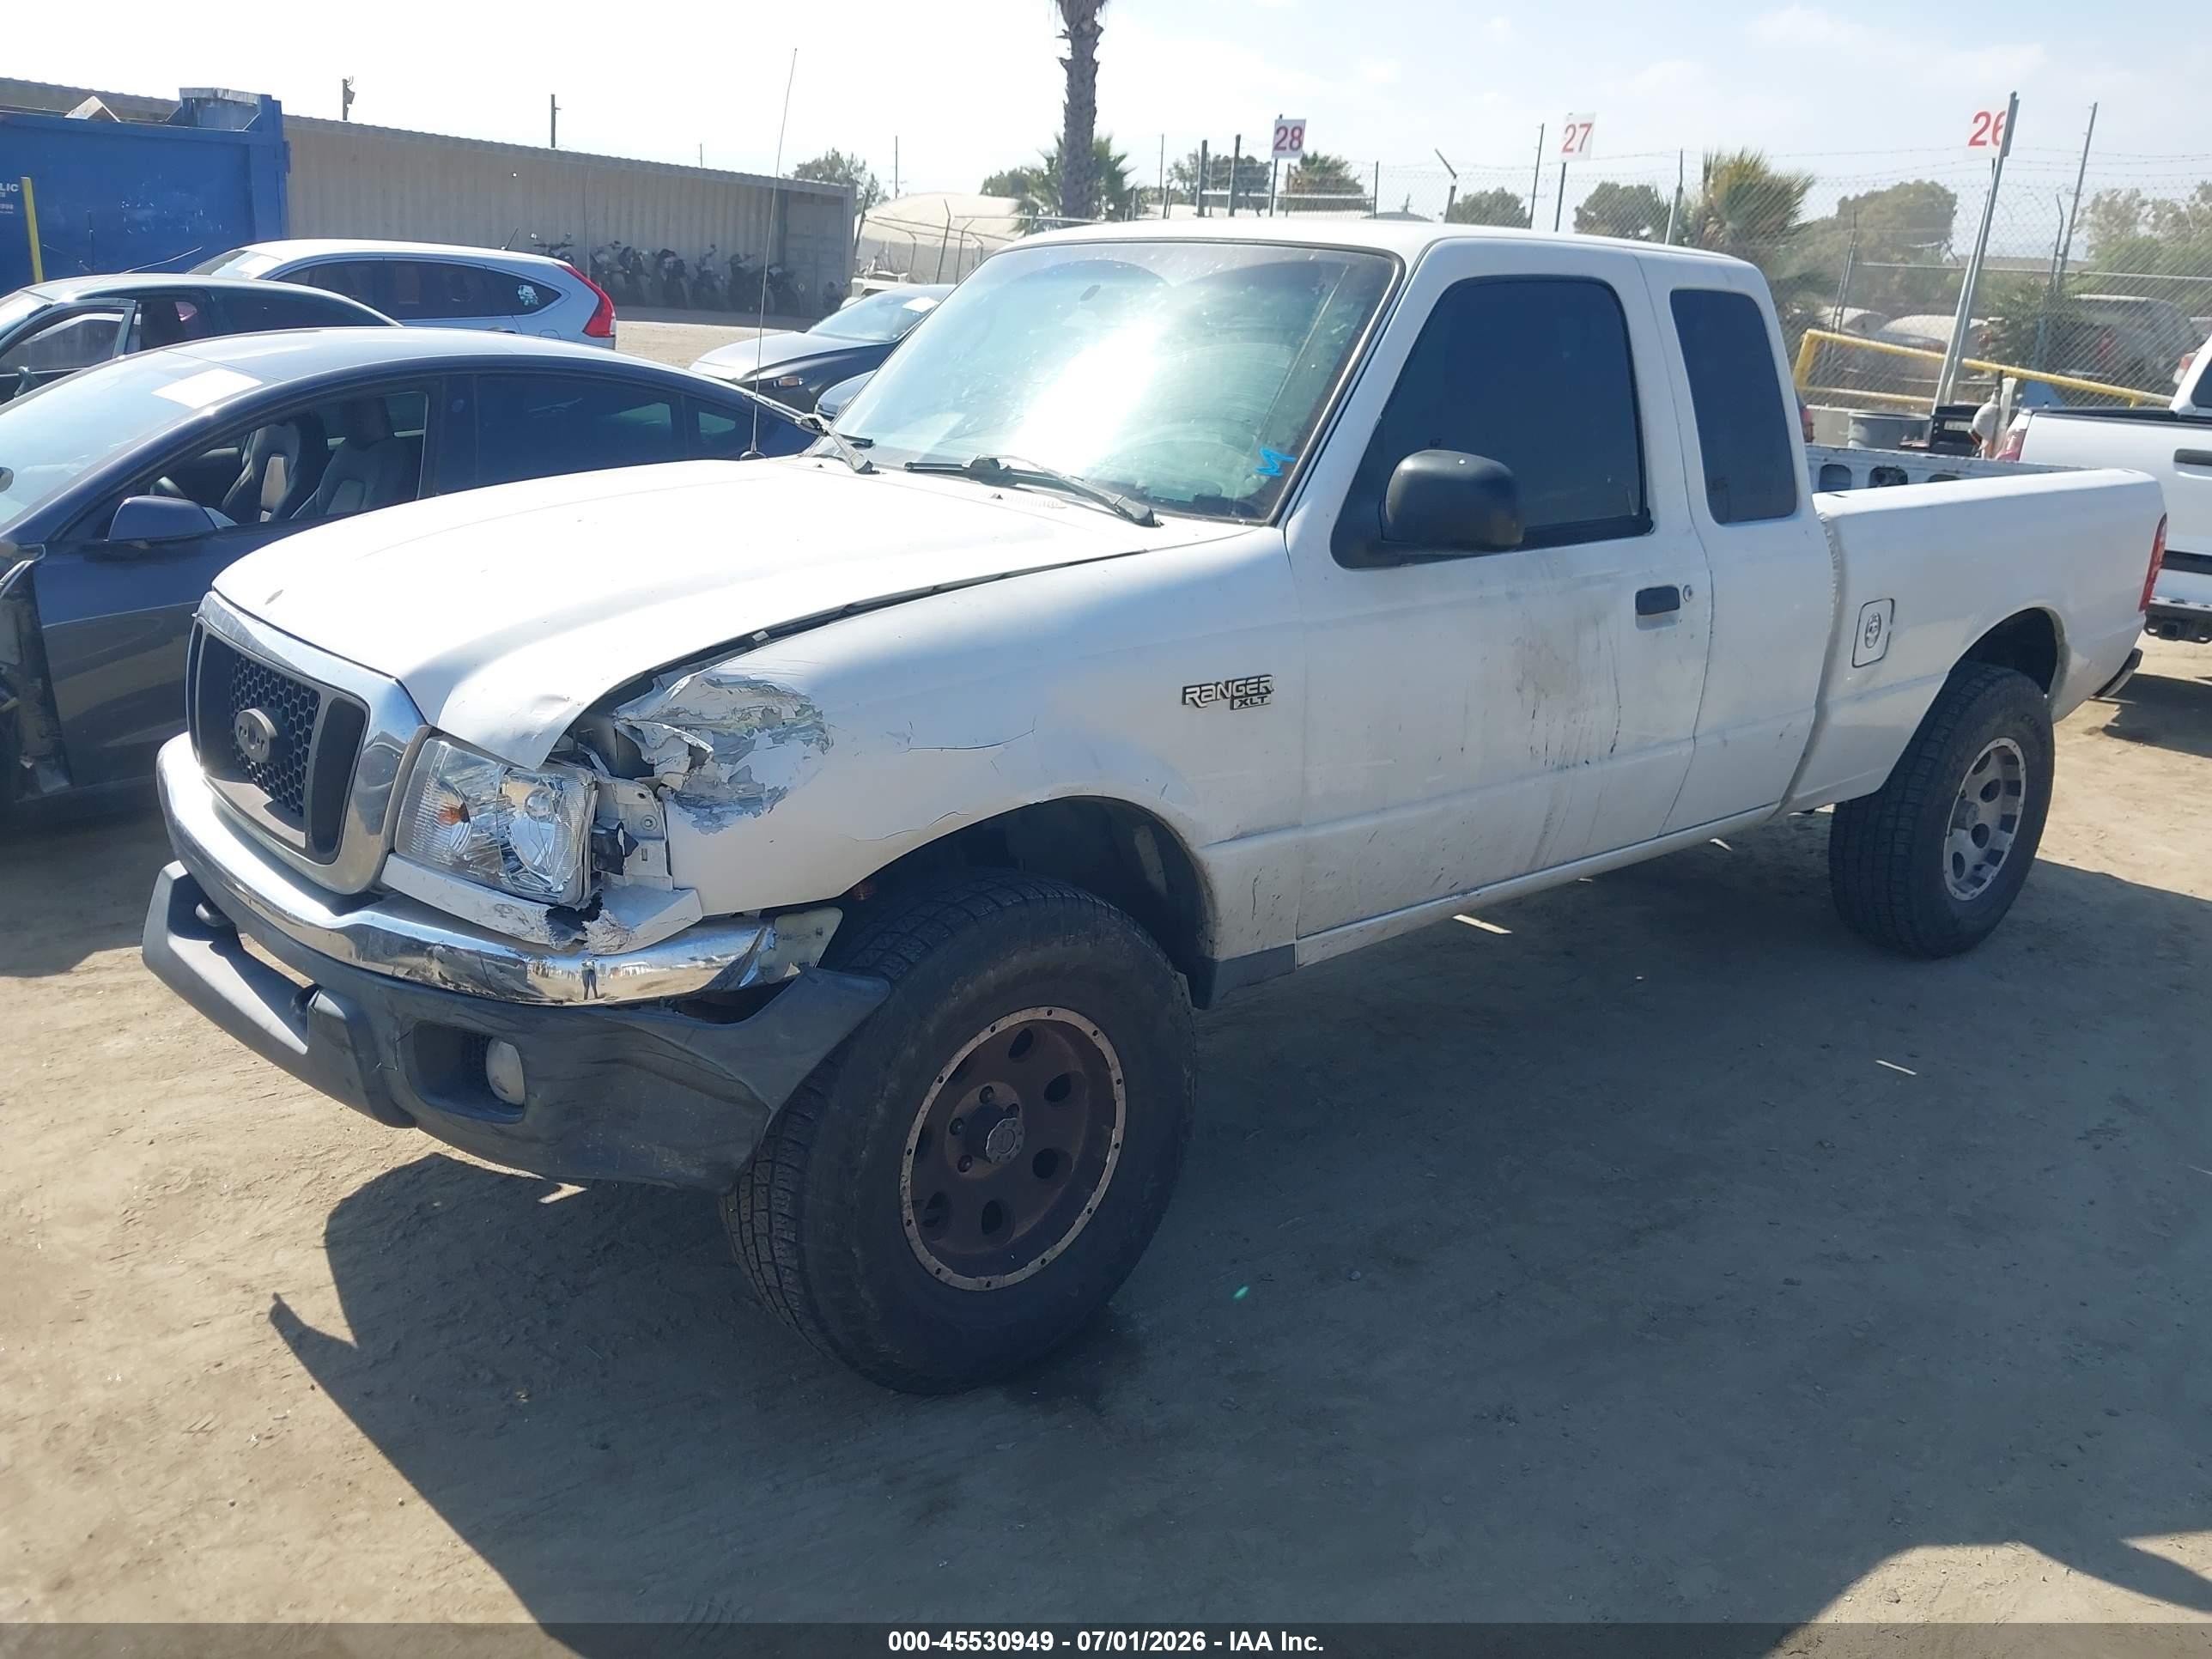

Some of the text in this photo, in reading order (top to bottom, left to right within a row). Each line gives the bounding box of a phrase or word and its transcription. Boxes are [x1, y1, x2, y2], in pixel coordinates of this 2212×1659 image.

[1274, 125, 1303, 151] 28
[1562, 123, 1592, 153] 27
[1182, 674, 1273, 708] RANGER
[1237, 696, 1268, 708] XLT
